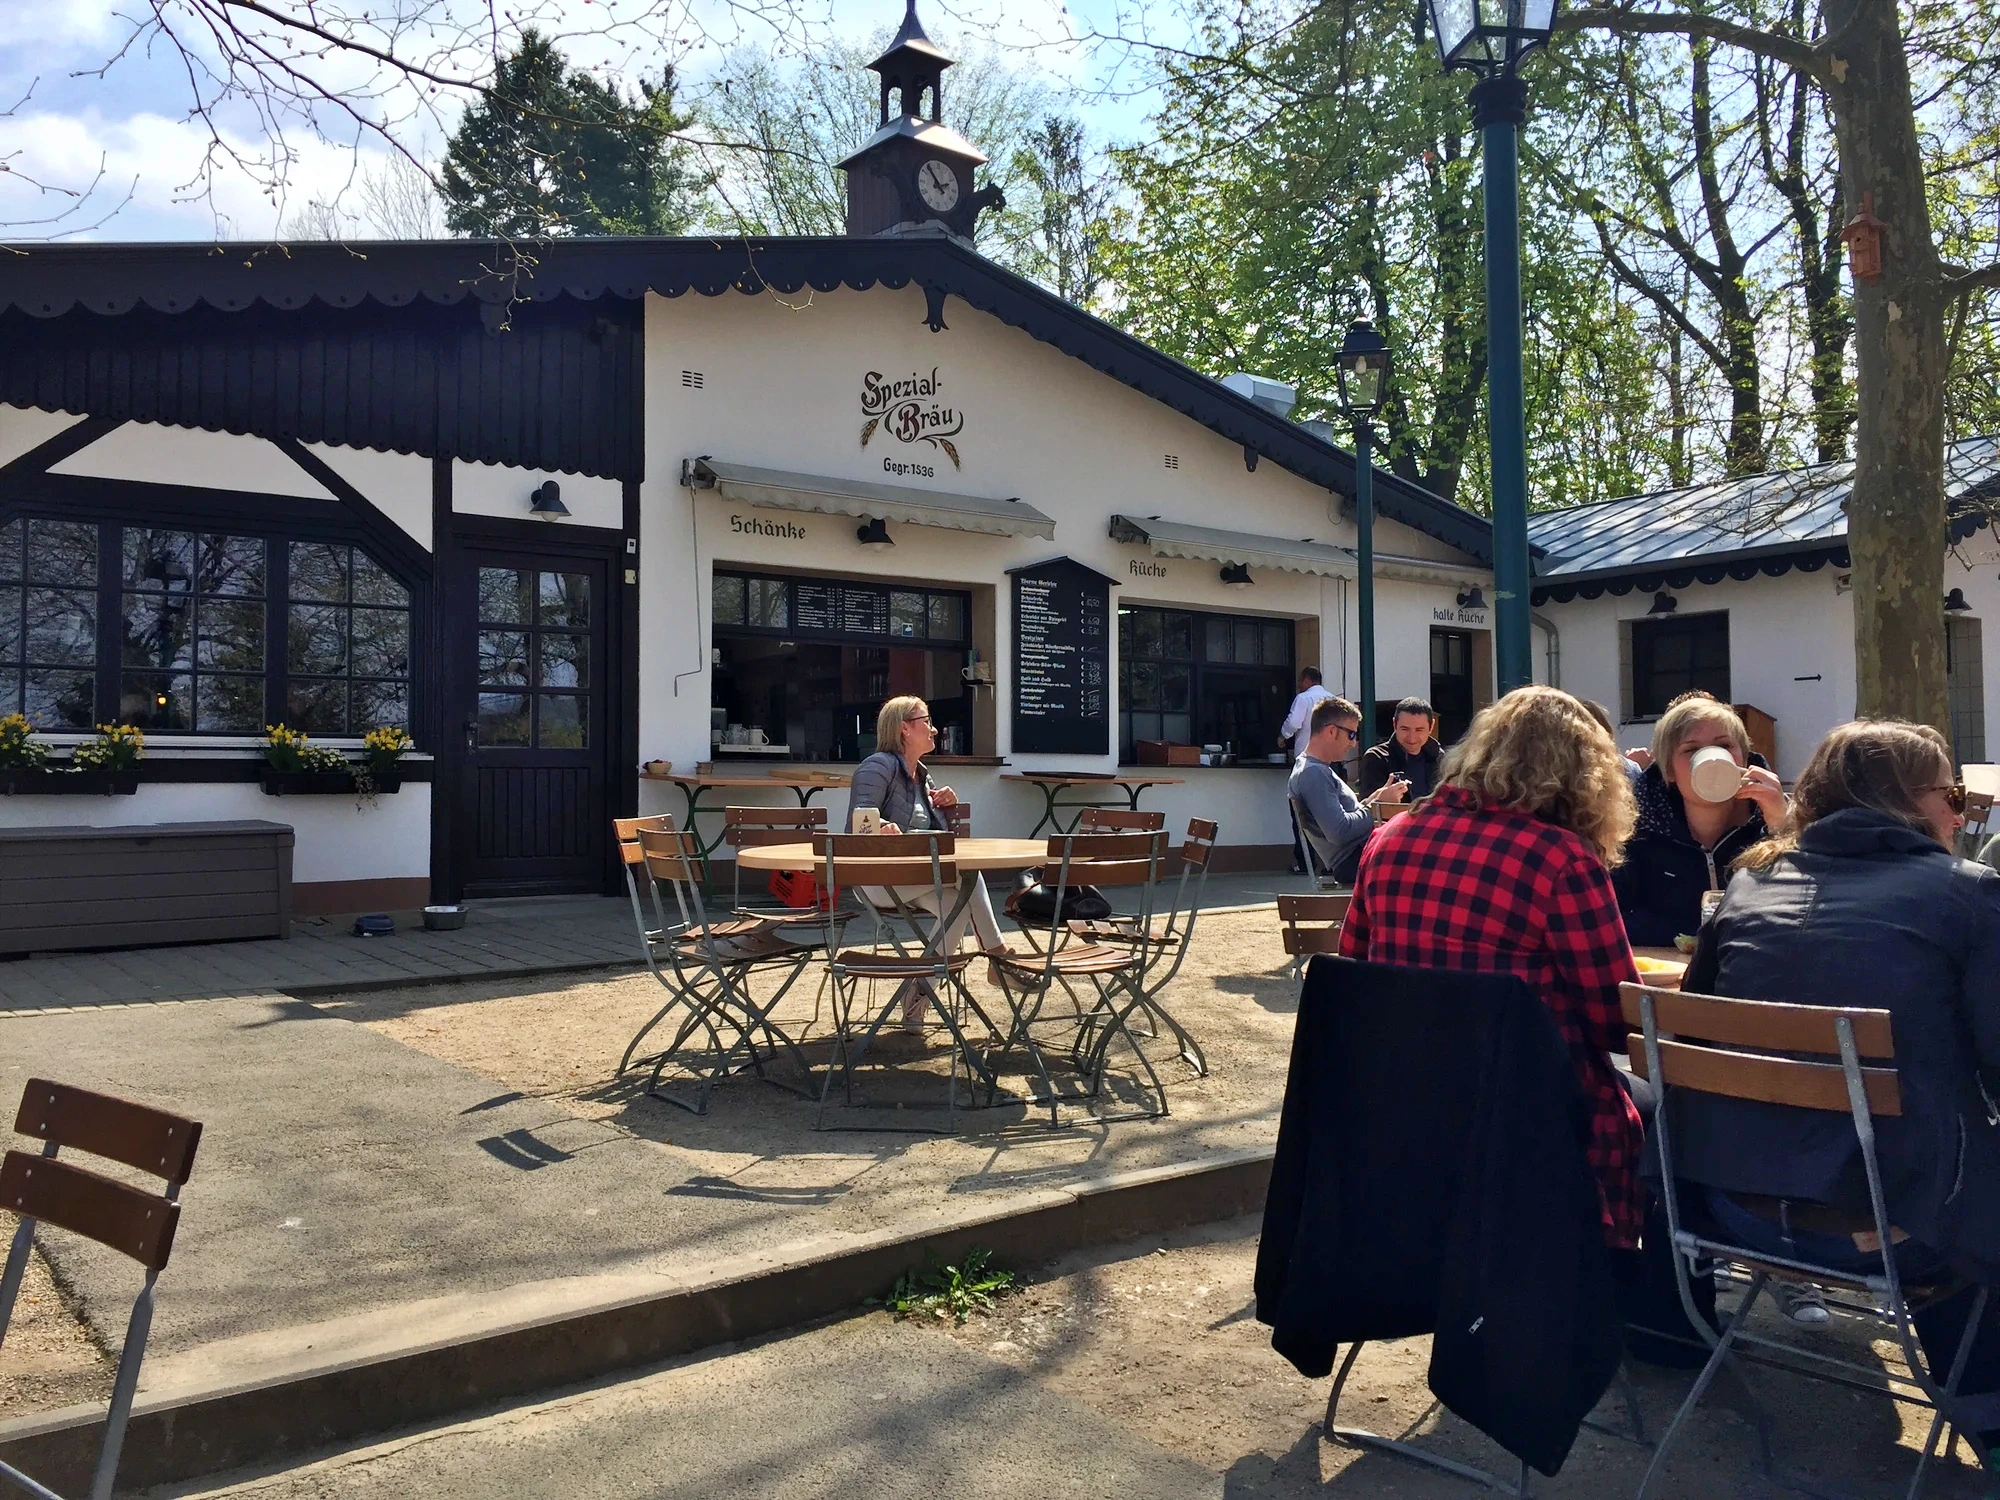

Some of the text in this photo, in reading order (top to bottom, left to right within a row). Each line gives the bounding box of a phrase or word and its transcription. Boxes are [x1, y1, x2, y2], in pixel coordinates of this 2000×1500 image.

[861, 366, 942, 410] Spezial-
[896, 403, 953, 443] Bräu
[731, 514, 806, 540] Schänke
[1129, 559, 1167, 578] Küche
[1433, 607, 1485, 624] kalte Küche
